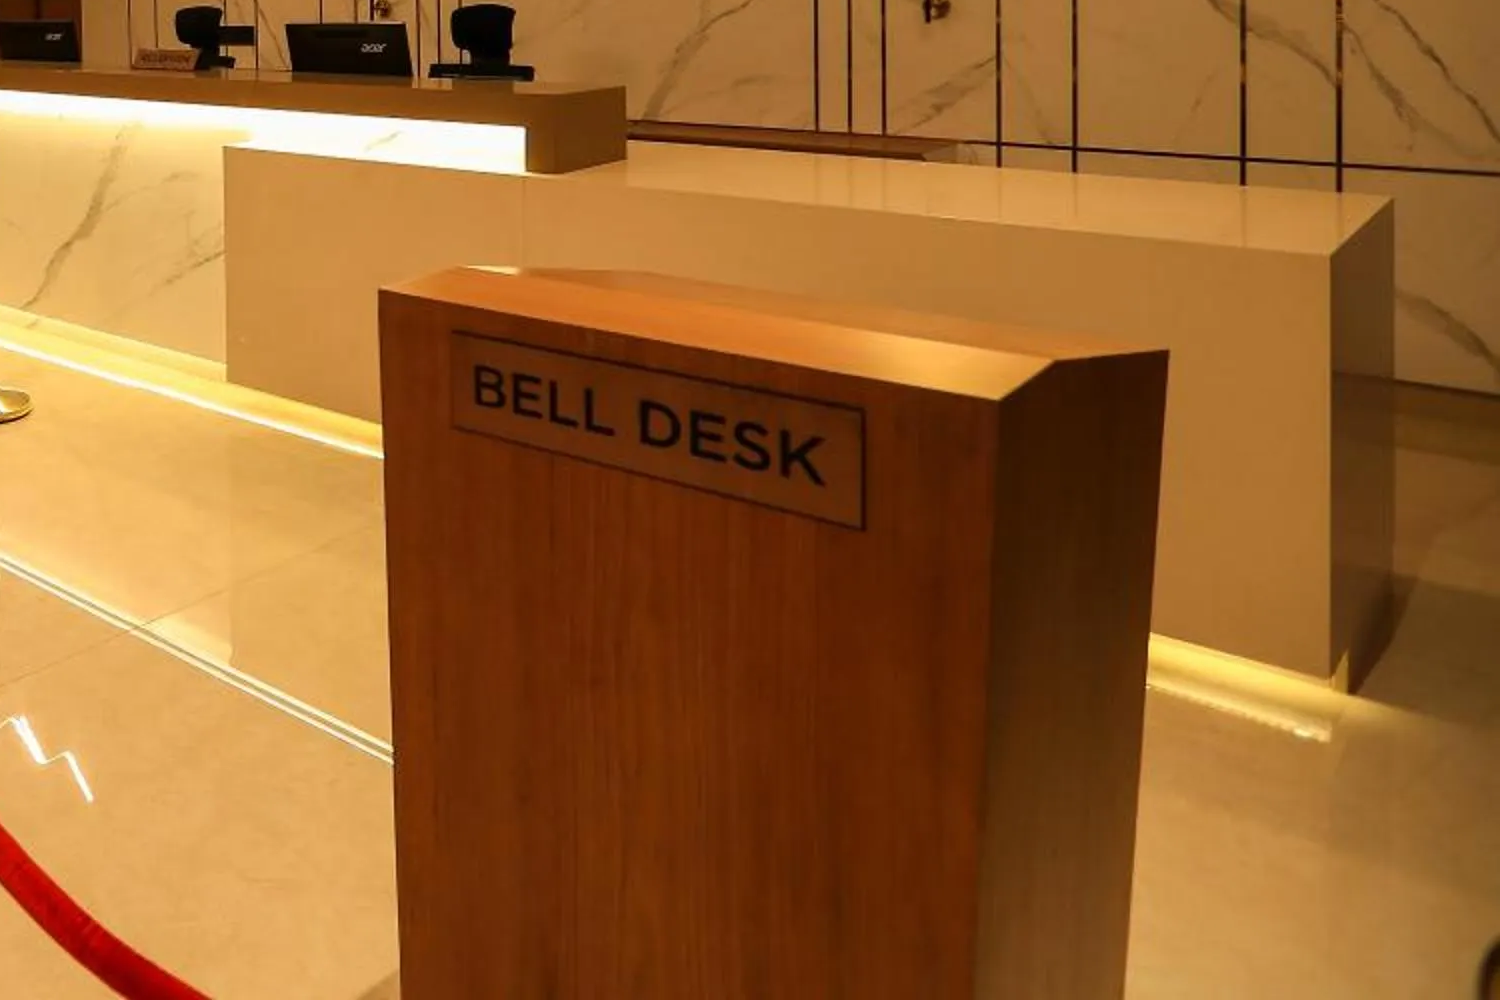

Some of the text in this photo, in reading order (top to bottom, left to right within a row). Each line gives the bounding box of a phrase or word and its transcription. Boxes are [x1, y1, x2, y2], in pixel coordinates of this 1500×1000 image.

[360, 43, 387, 53] acer
[473, 365, 826, 487] BELL DESK
